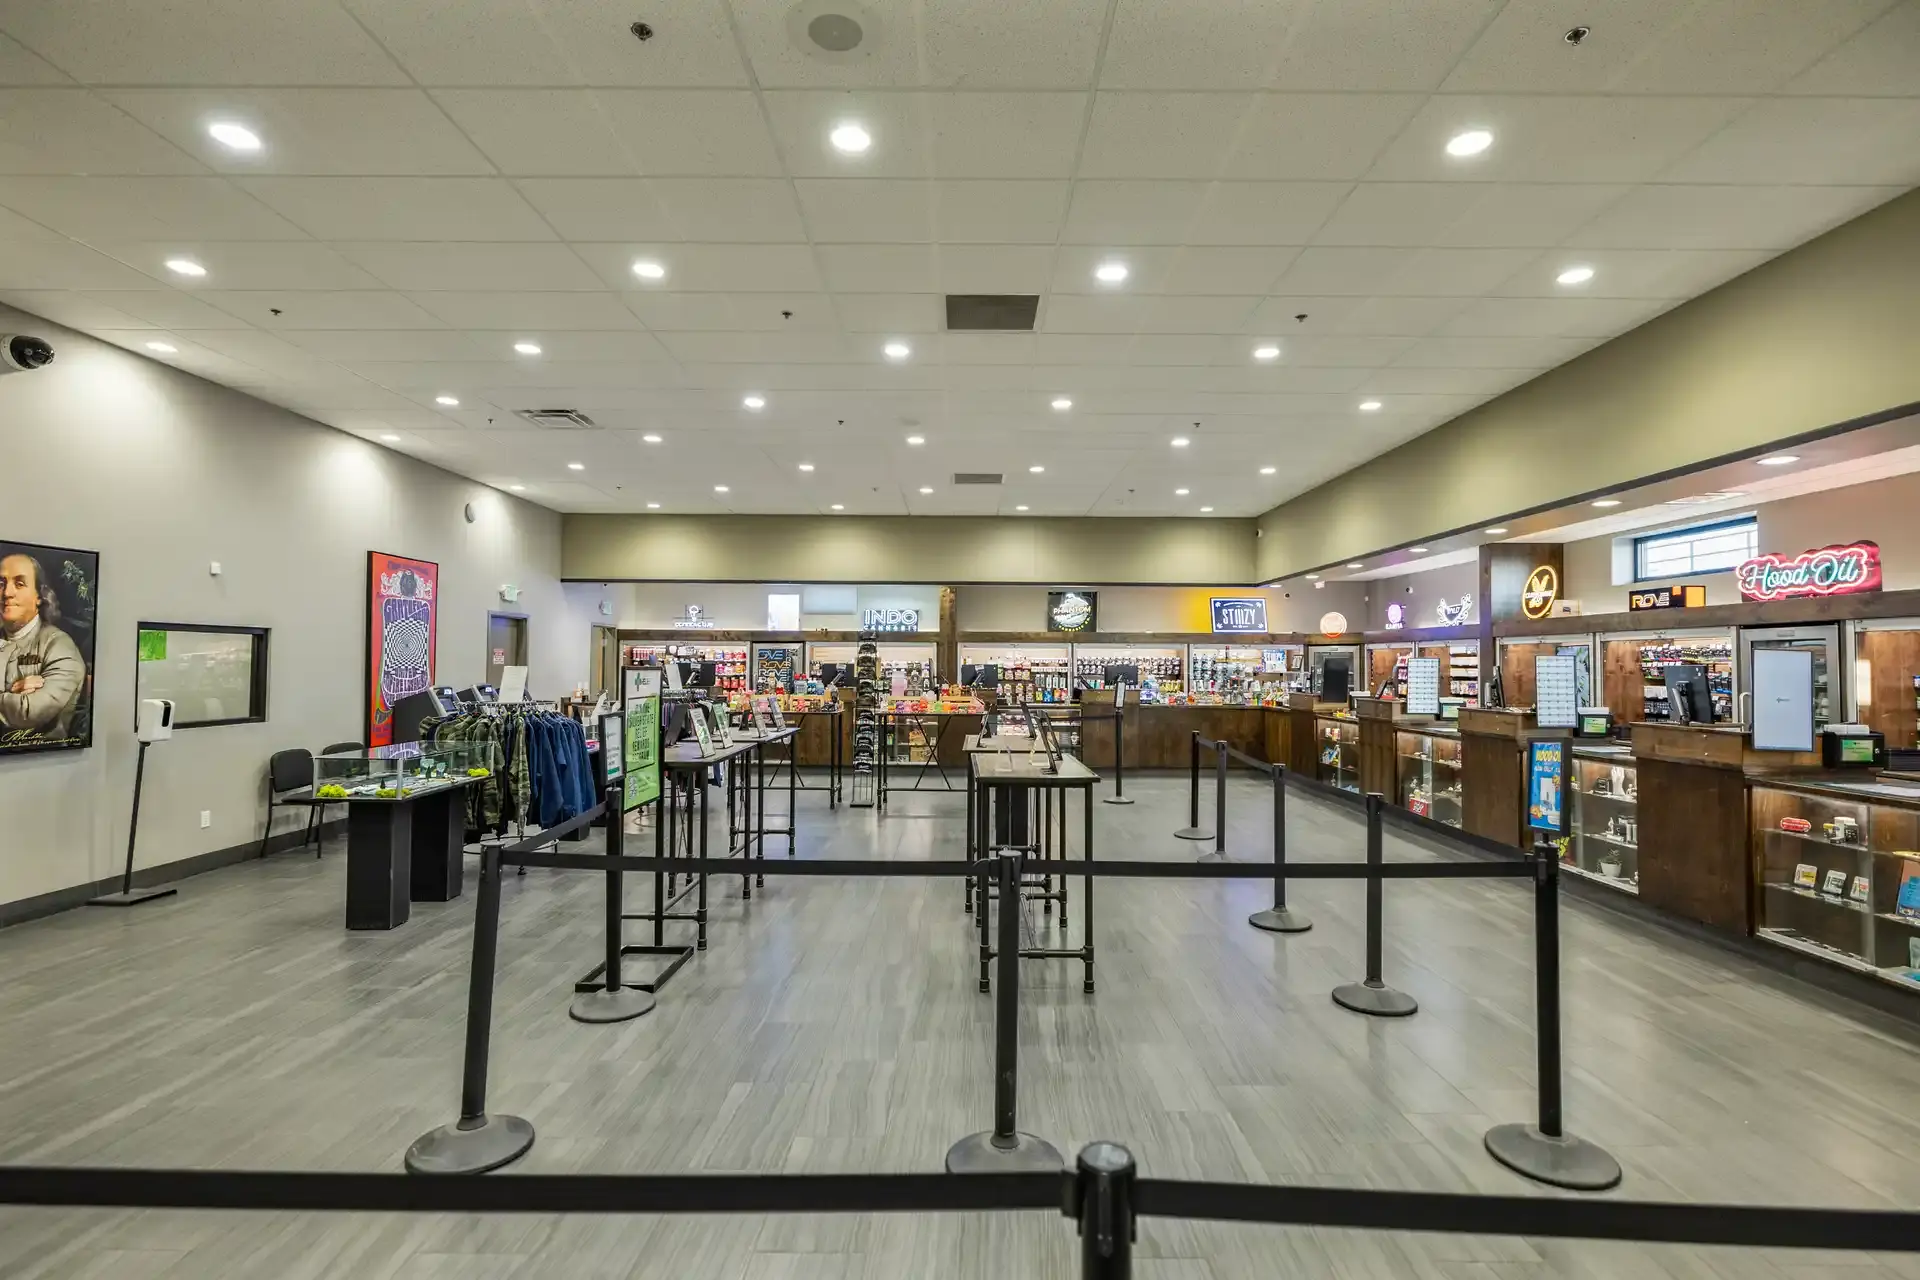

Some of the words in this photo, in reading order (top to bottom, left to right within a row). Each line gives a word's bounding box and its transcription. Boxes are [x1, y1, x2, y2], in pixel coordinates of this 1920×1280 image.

[1742, 562, 1810, 594] Hood
[1811, 554, 1860, 586] Oil
[1632, 592, 1670, 608] ROVE
[865, 609, 918, 625] INDO
[1053, 606, 1091, 615] PHANTOM
[863, 624, 918, 632] CANNABIS
